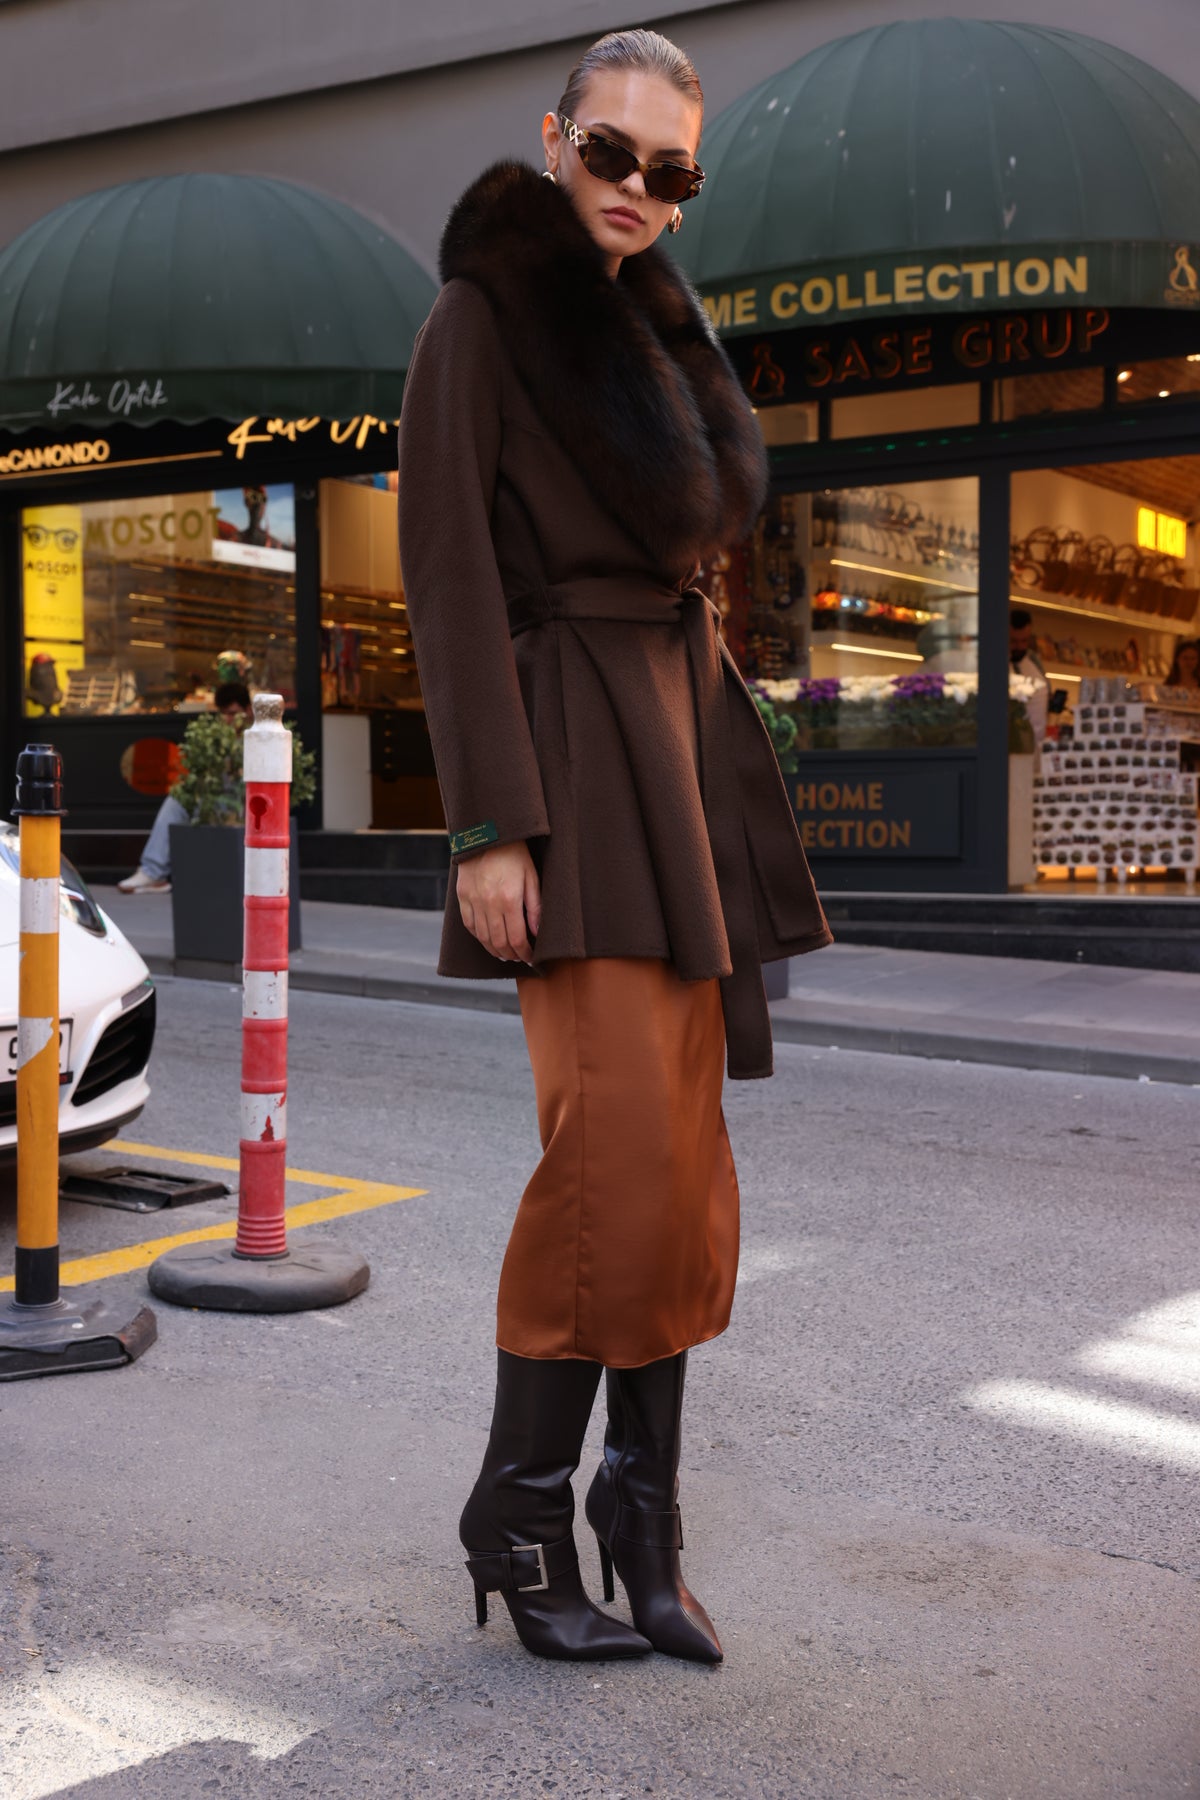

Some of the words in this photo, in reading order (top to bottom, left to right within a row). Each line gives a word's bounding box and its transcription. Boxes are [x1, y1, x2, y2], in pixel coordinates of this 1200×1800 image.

[770, 257, 1088, 319] COLLECTION
[953, 308, 1109, 367] GRUP
[107, 378, 168, 416] Optik
[86, 507, 221, 548] MOSCOT
[796, 783, 883, 811] HOME
[801, 820, 911, 848] ECTION
